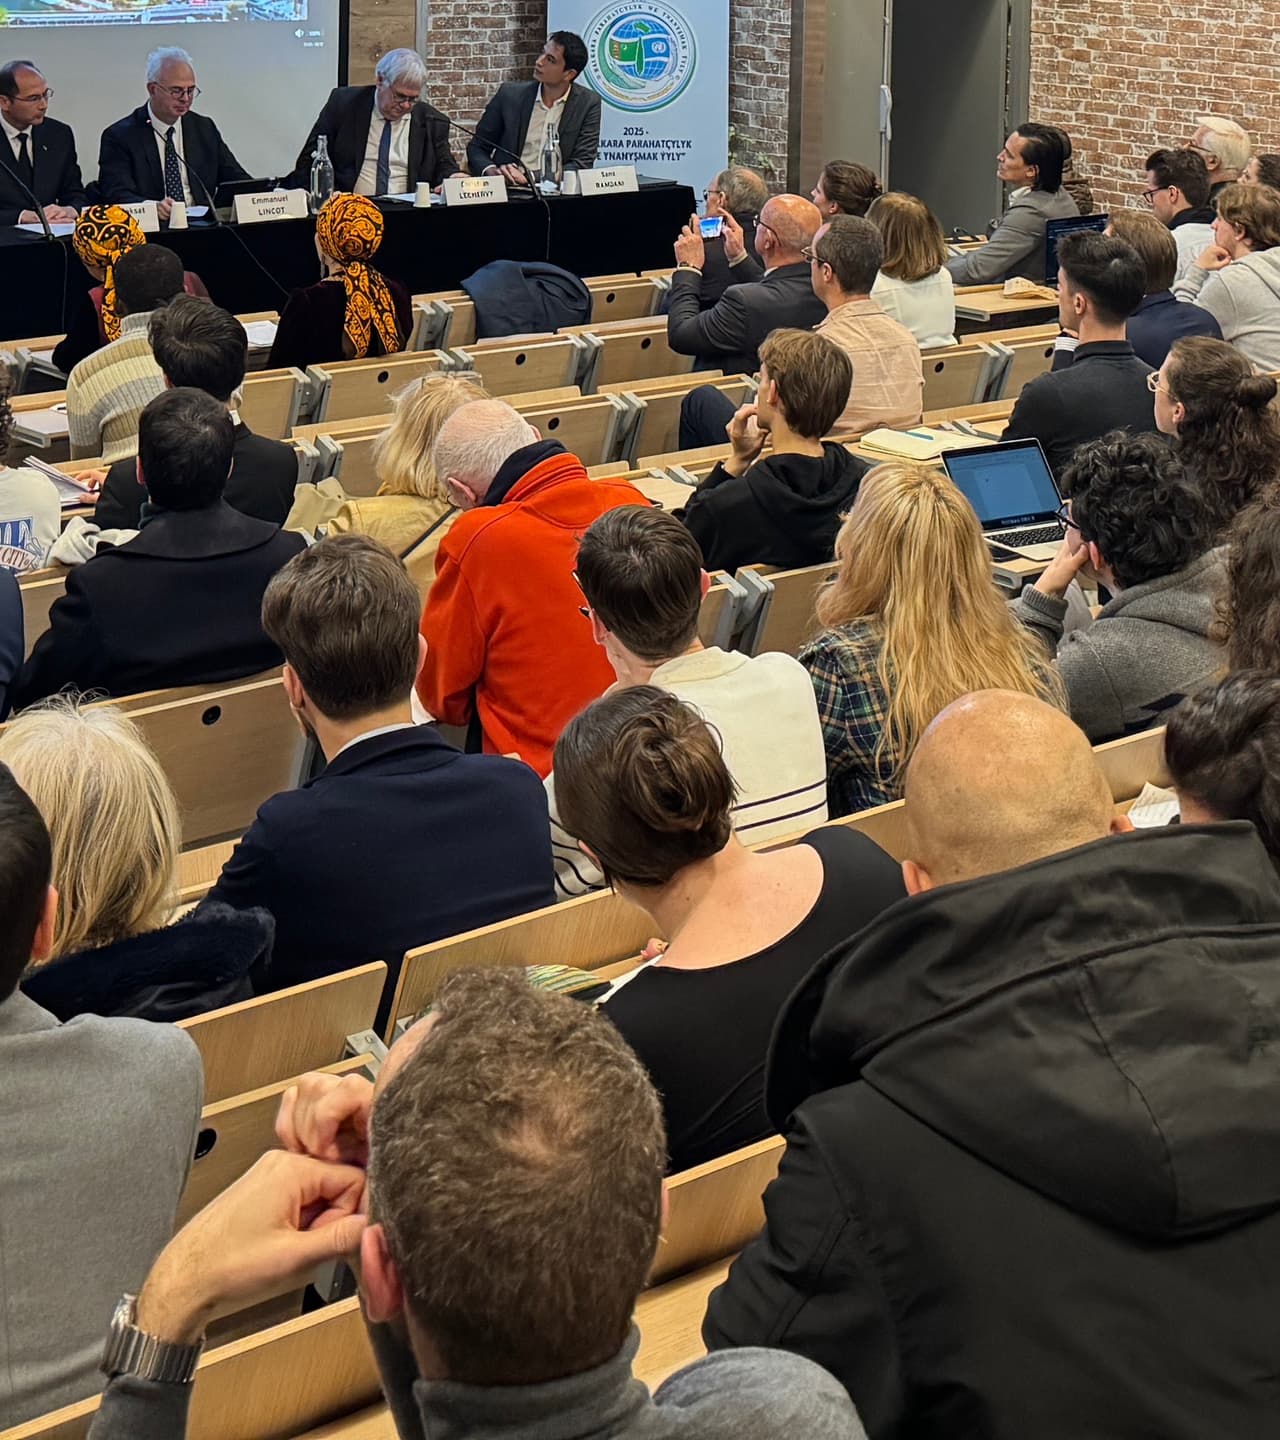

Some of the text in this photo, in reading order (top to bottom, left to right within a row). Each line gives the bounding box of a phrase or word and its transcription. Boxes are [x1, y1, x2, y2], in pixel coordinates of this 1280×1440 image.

[623, 127, 644, 136] 2025
[251, 194, 289, 205] Emmanuel
[257, 207, 286, 216] LINCOT
